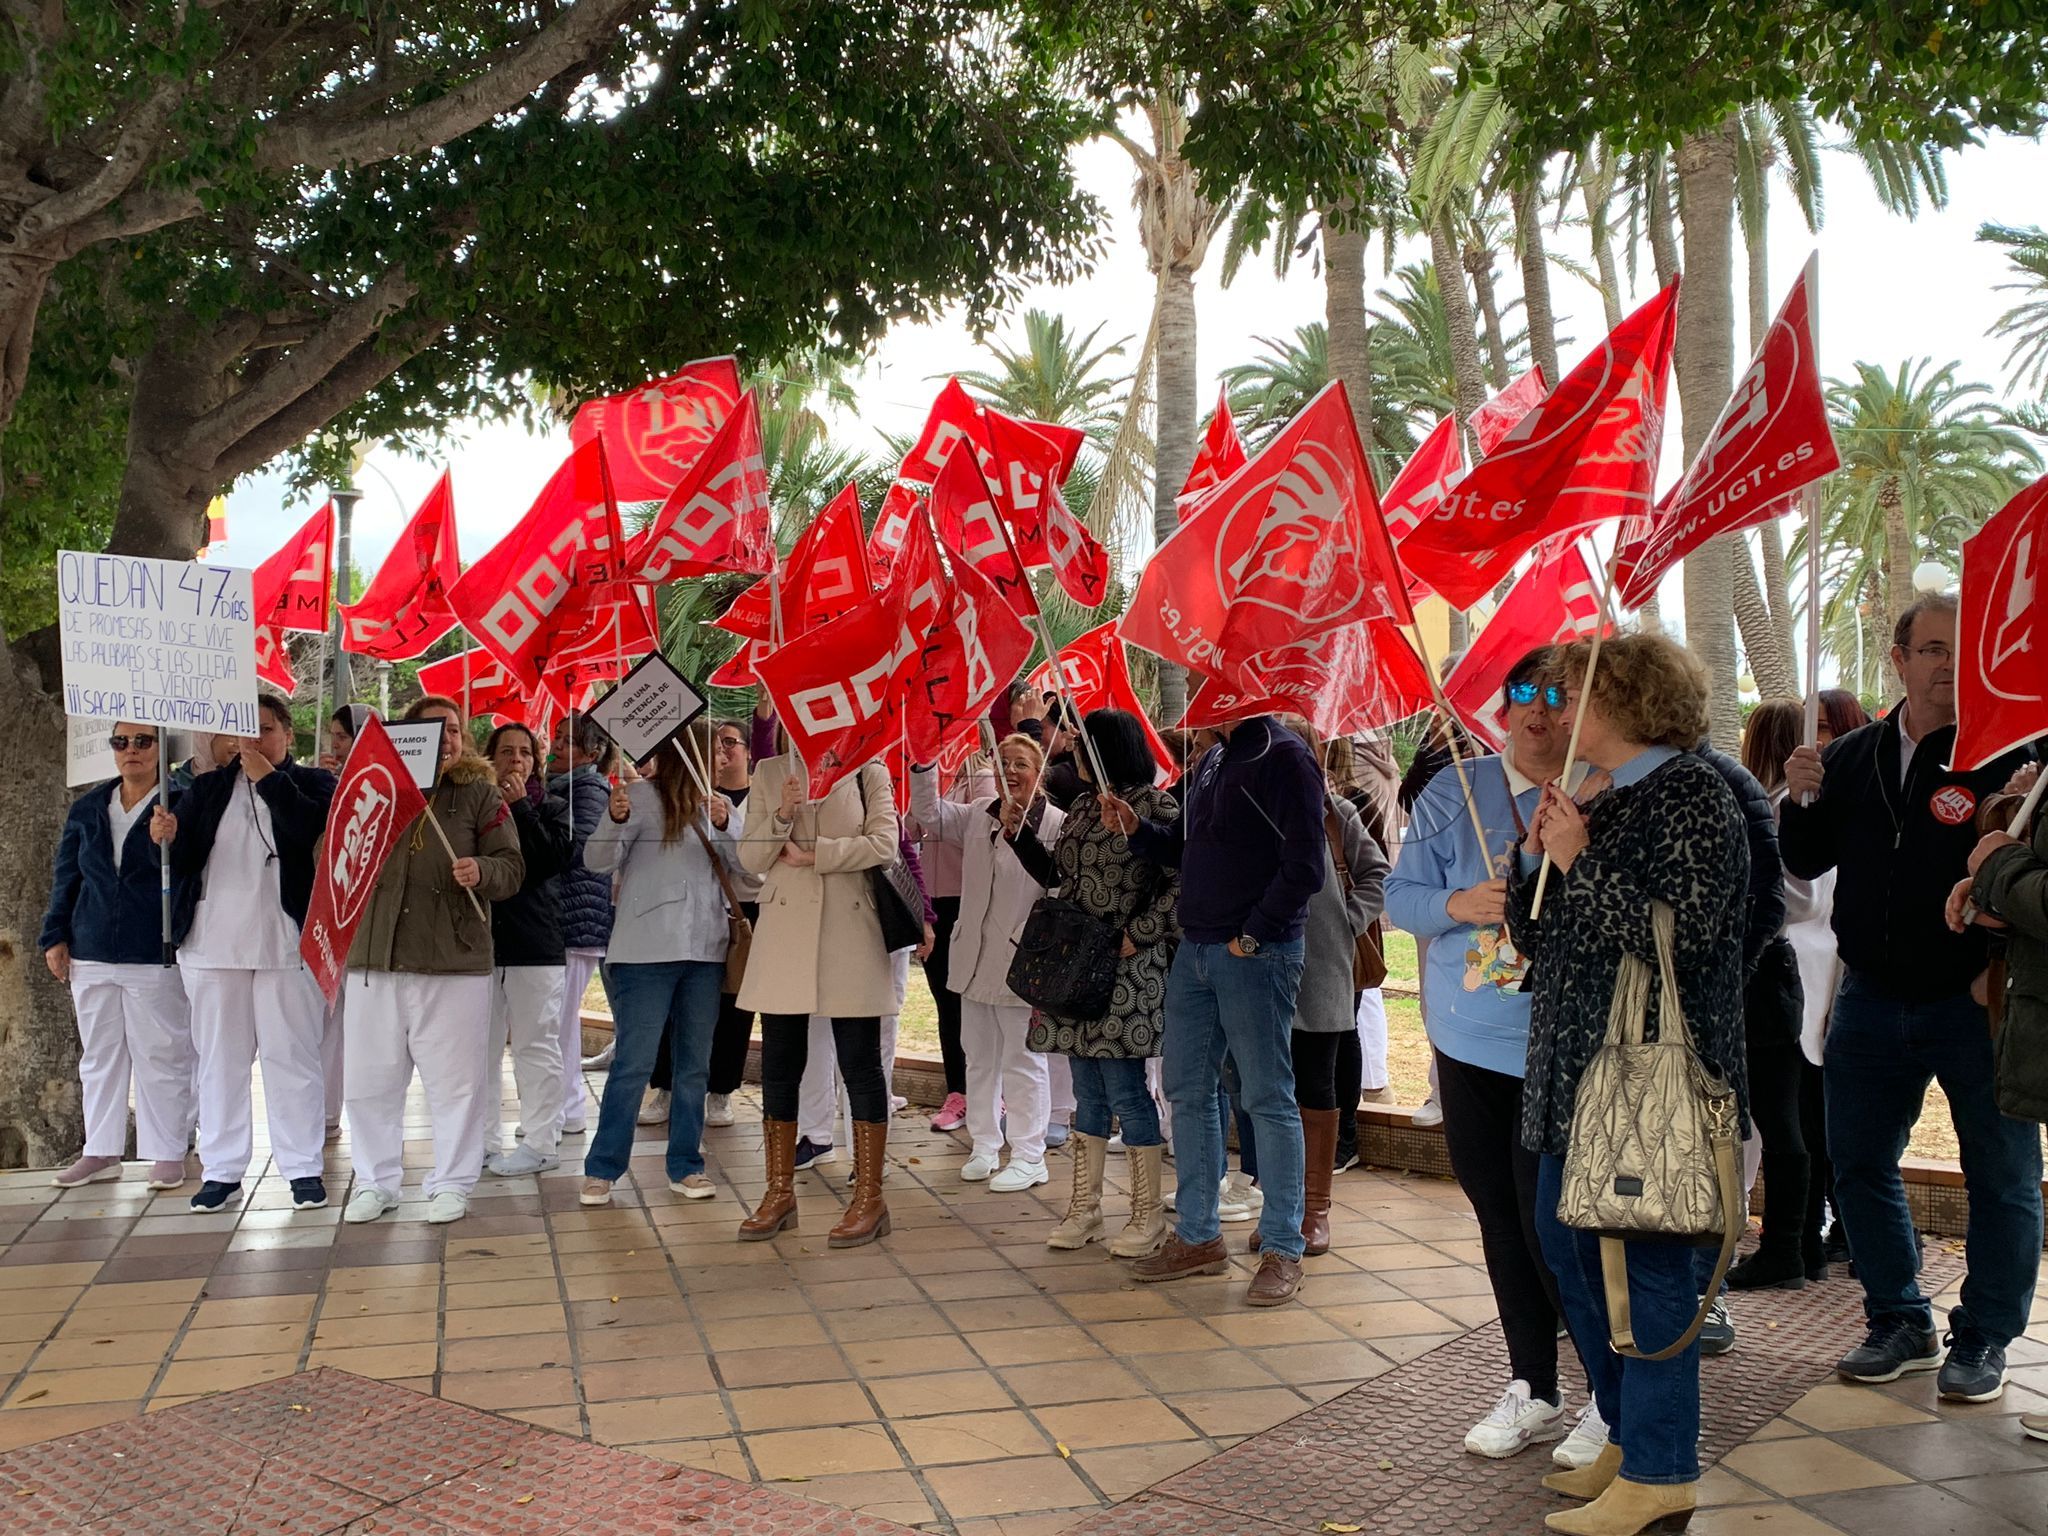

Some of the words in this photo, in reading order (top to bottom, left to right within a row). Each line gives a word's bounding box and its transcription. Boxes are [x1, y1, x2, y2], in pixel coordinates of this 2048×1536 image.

[61, 553, 164, 611] QUEDAN
[178, 565, 232, 616] 47
[221, 591, 249, 621] DÍAS
[64, 610, 83, 634] DE
[89, 612, 153, 640] PROMESAS
[159, 621, 176, 644] NO
[182, 622, 197, 646] SE
[65, 641, 87, 663] LAS
[91, 641, 145, 670] PALABRAS
[149, 648, 164, 672] SE
[167, 650, 193, 675] LAS
[198, 652, 237, 680] LLEVA
[622, 697, 634, 709] OR
[634, 683, 651, 700] UNA
[622, 691, 659, 727] SISTENCIA
[658, 682, 670, 693] DE
[636, 700, 668, 728] CALIDAD
[133, 696, 150, 720] EL
[152, 699, 215, 725] CONTRATO
[217, 700, 257, 734] YA!!!
[643, 714, 668, 738] CONTRATO
